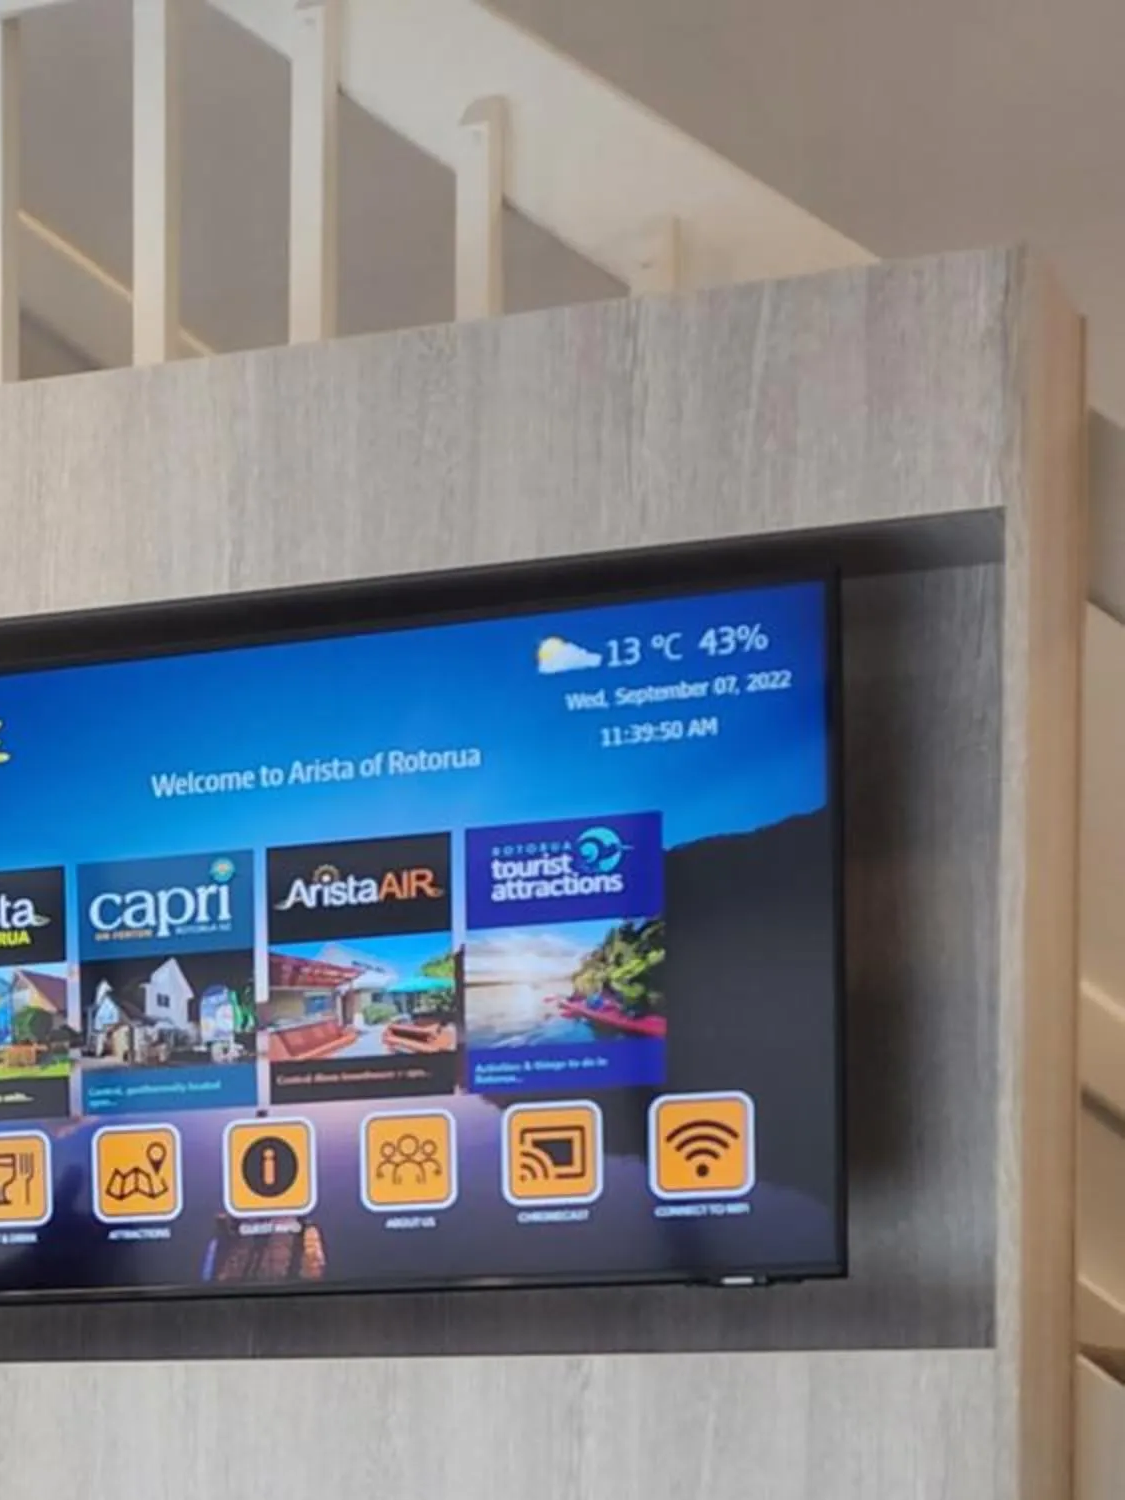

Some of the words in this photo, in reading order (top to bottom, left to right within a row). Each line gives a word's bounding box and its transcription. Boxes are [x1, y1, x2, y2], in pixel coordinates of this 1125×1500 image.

[606, 636, 642, 668] 13
[699, 623, 769, 656] 43%
[615, 680, 710, 707] September
[713, 675, 741, 696] 07,
[746, 669, 792, 693] 2022
[600, 718, 684, 748] 11:39:50
[687, 716, 719, 738] AM
[151, 770, 255, 798] Welcome
[260, 765, 284, 789] to
[288, 758, 354, 785] Arista
[360, 752, 385, 778] of
[389, 747, 481, 775] Rotorua
[491, 852, 574, 880] tourist
[89, 862, 234, 937] capri
[491, 872, 624, 902] attractions
